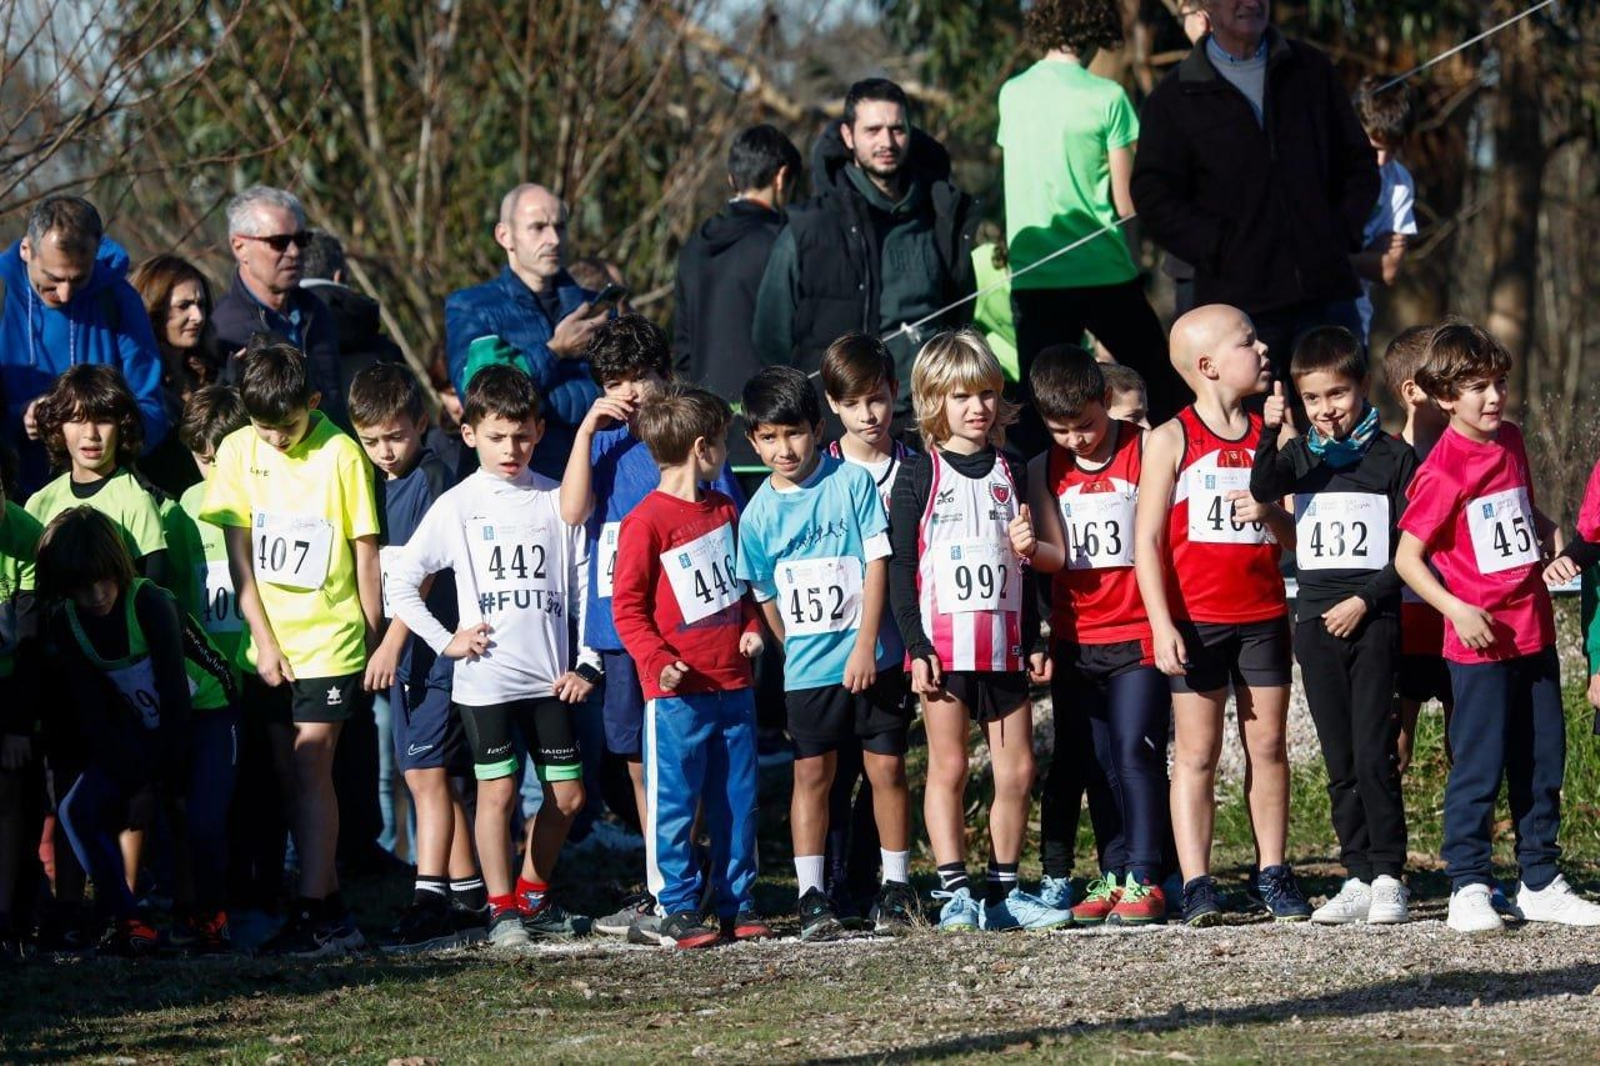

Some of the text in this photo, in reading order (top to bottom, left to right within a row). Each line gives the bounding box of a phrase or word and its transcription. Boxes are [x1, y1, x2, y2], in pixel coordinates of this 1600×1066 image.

[259, 535, 310, 574] 407
[1072, 520, 1121, 557] 463
[1310, 520, 1368, 557] 432
[489, 544, 546, 580] 442
[695, 554, 737, 604] 446
[955, 564, 1007, 600] 992
[790, 585, 844, 623] 452
